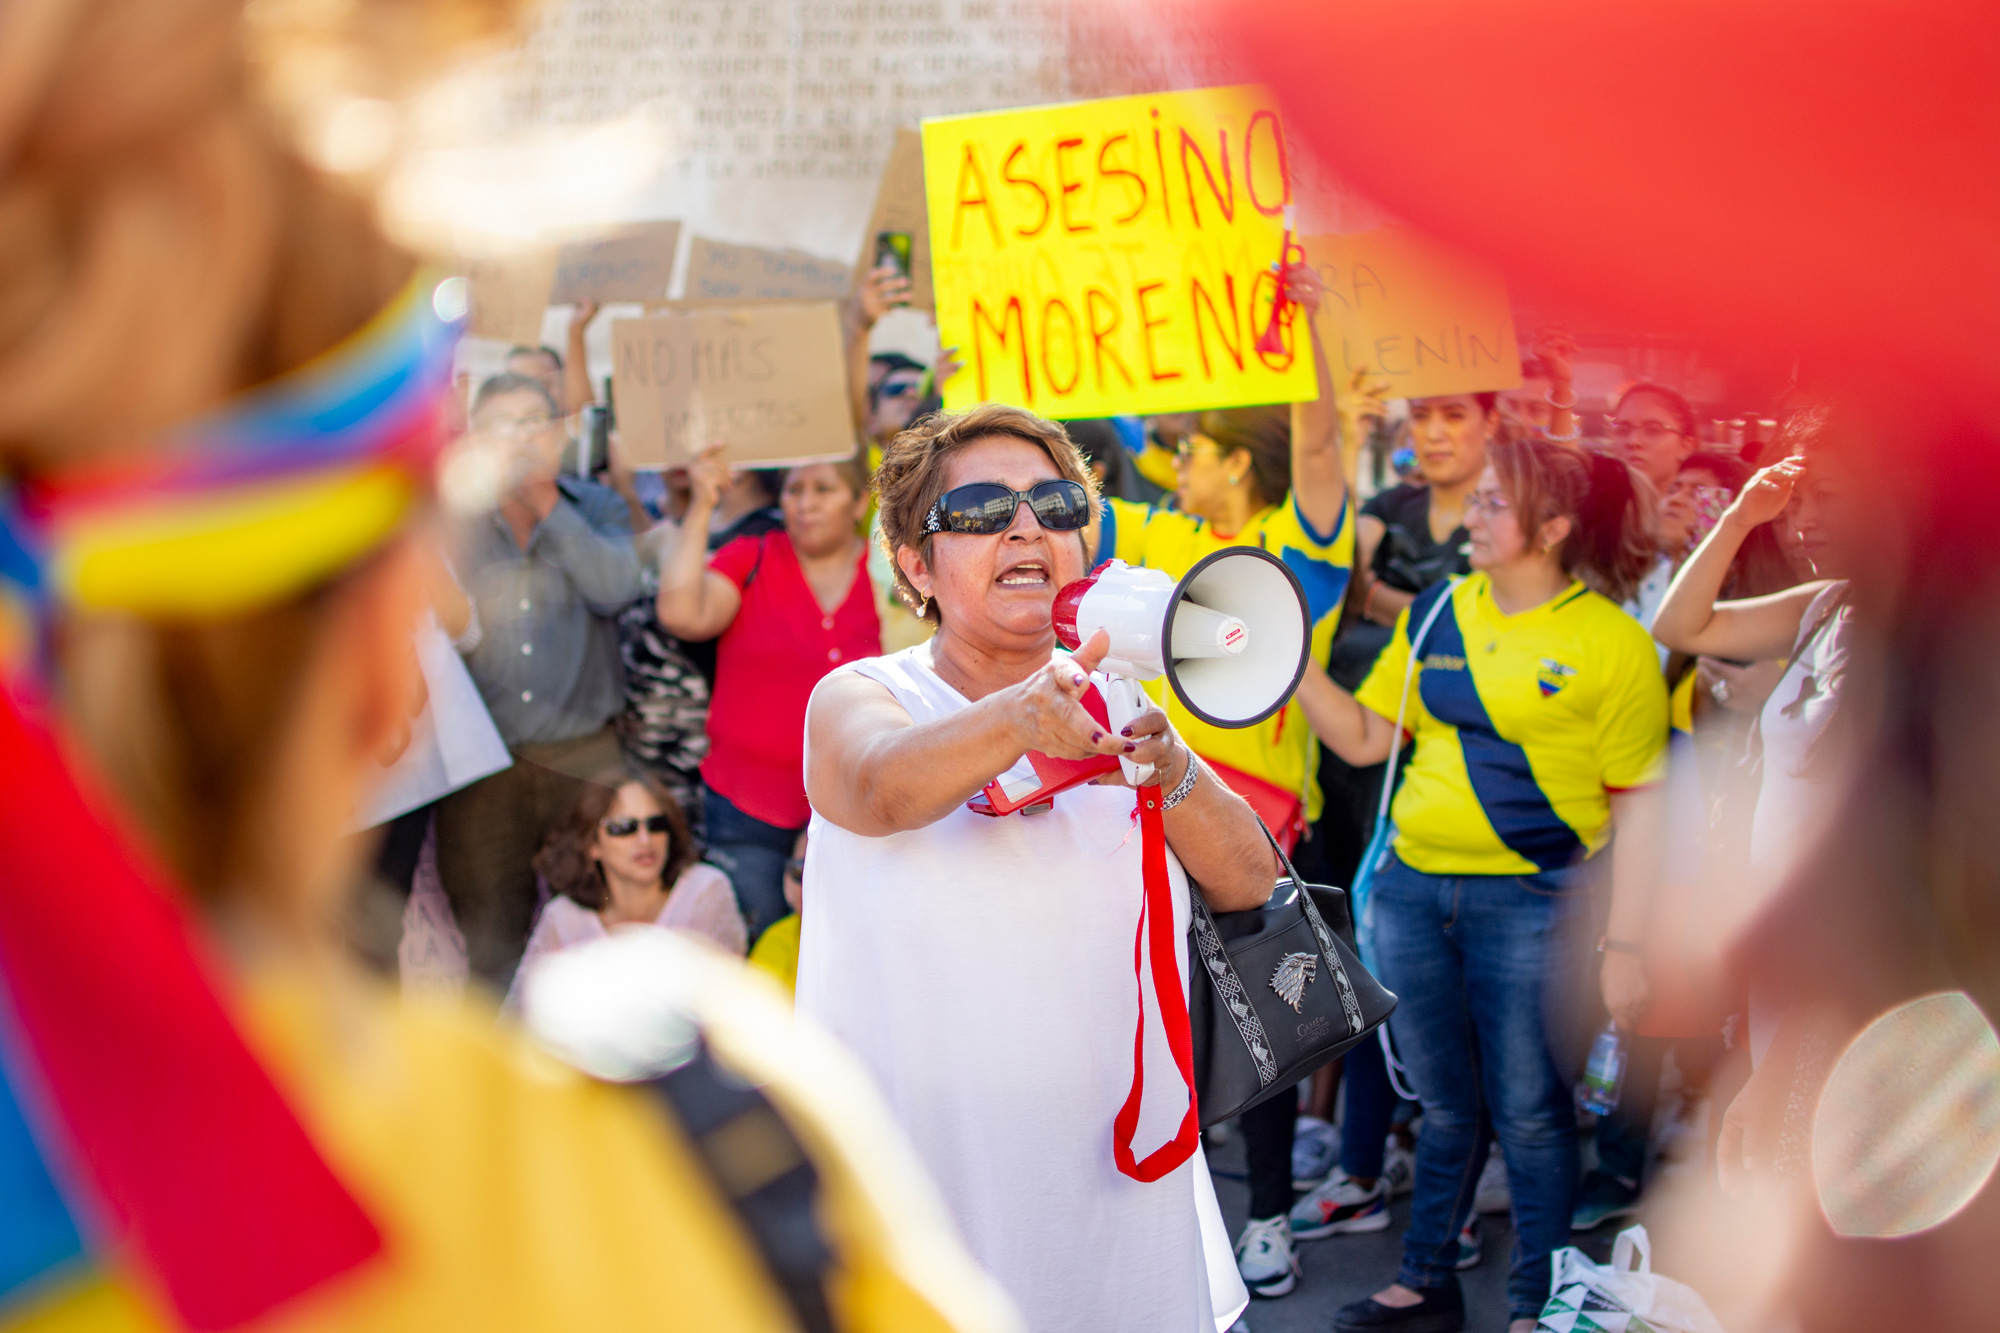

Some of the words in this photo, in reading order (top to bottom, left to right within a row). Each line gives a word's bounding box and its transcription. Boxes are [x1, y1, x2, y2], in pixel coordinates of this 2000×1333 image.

[621, 336, 679, 389] NO
[972, 271, 1297, 404] MORENO
[1342, 322, 1504, 376] LENIN
